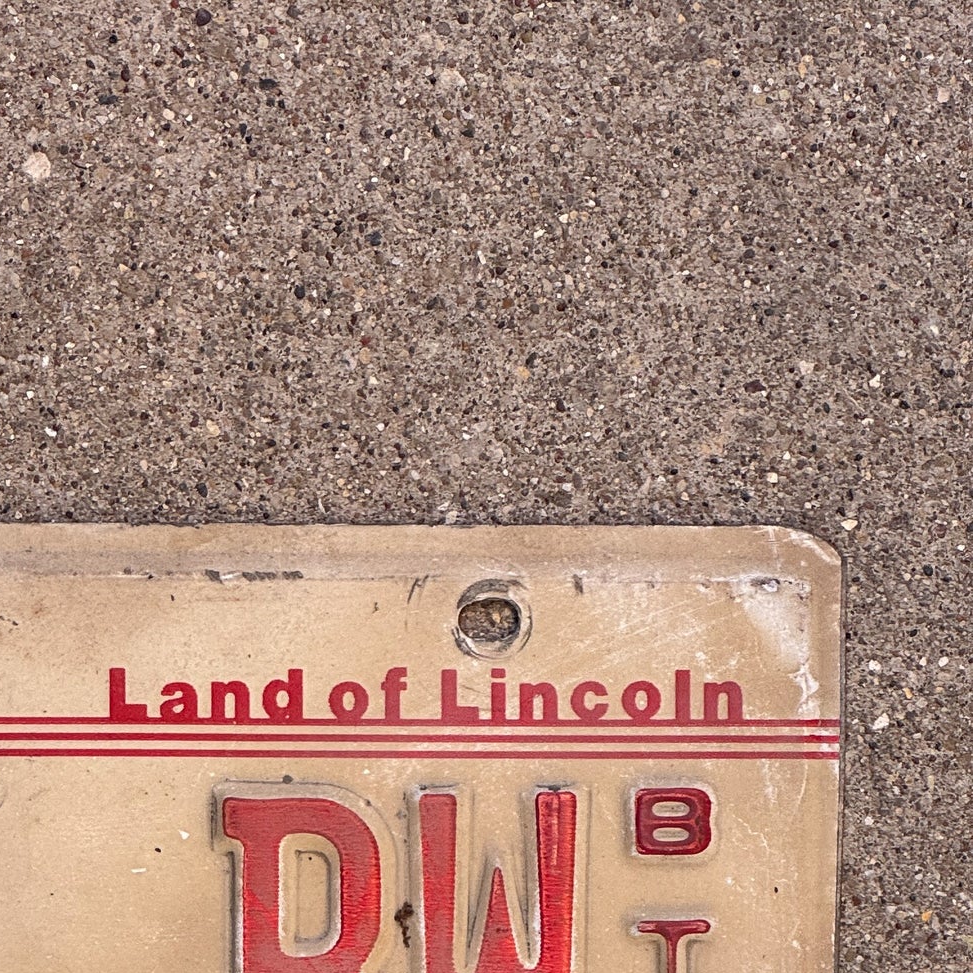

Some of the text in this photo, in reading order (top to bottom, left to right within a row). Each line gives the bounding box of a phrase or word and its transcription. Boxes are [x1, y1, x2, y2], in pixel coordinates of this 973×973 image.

[108, 667, 745, 722] Land of Lincoln
[634, 787, 714, 857] B
